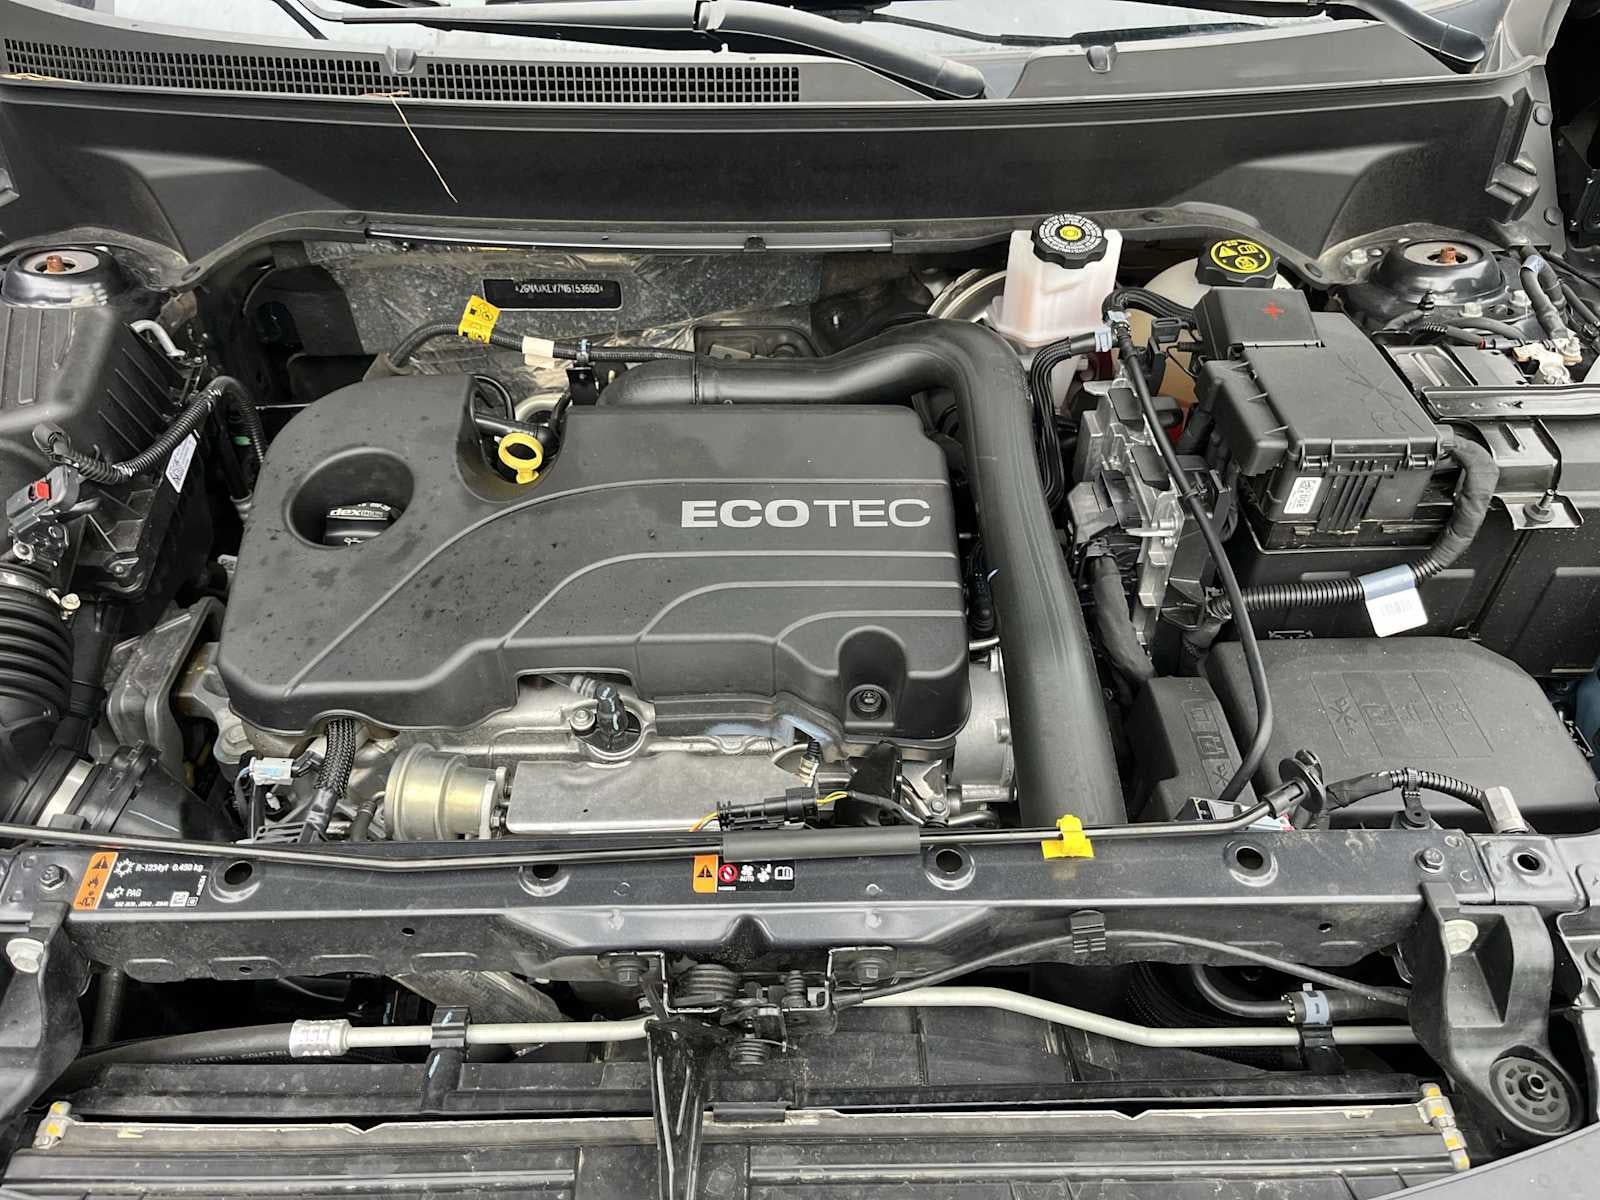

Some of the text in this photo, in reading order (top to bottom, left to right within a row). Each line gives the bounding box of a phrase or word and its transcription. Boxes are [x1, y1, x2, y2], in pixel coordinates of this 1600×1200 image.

[681, 498, 932, 528] ECOTEC
[193, 863, 204, 873] kg
[125, 888, 142, 897] PAG
